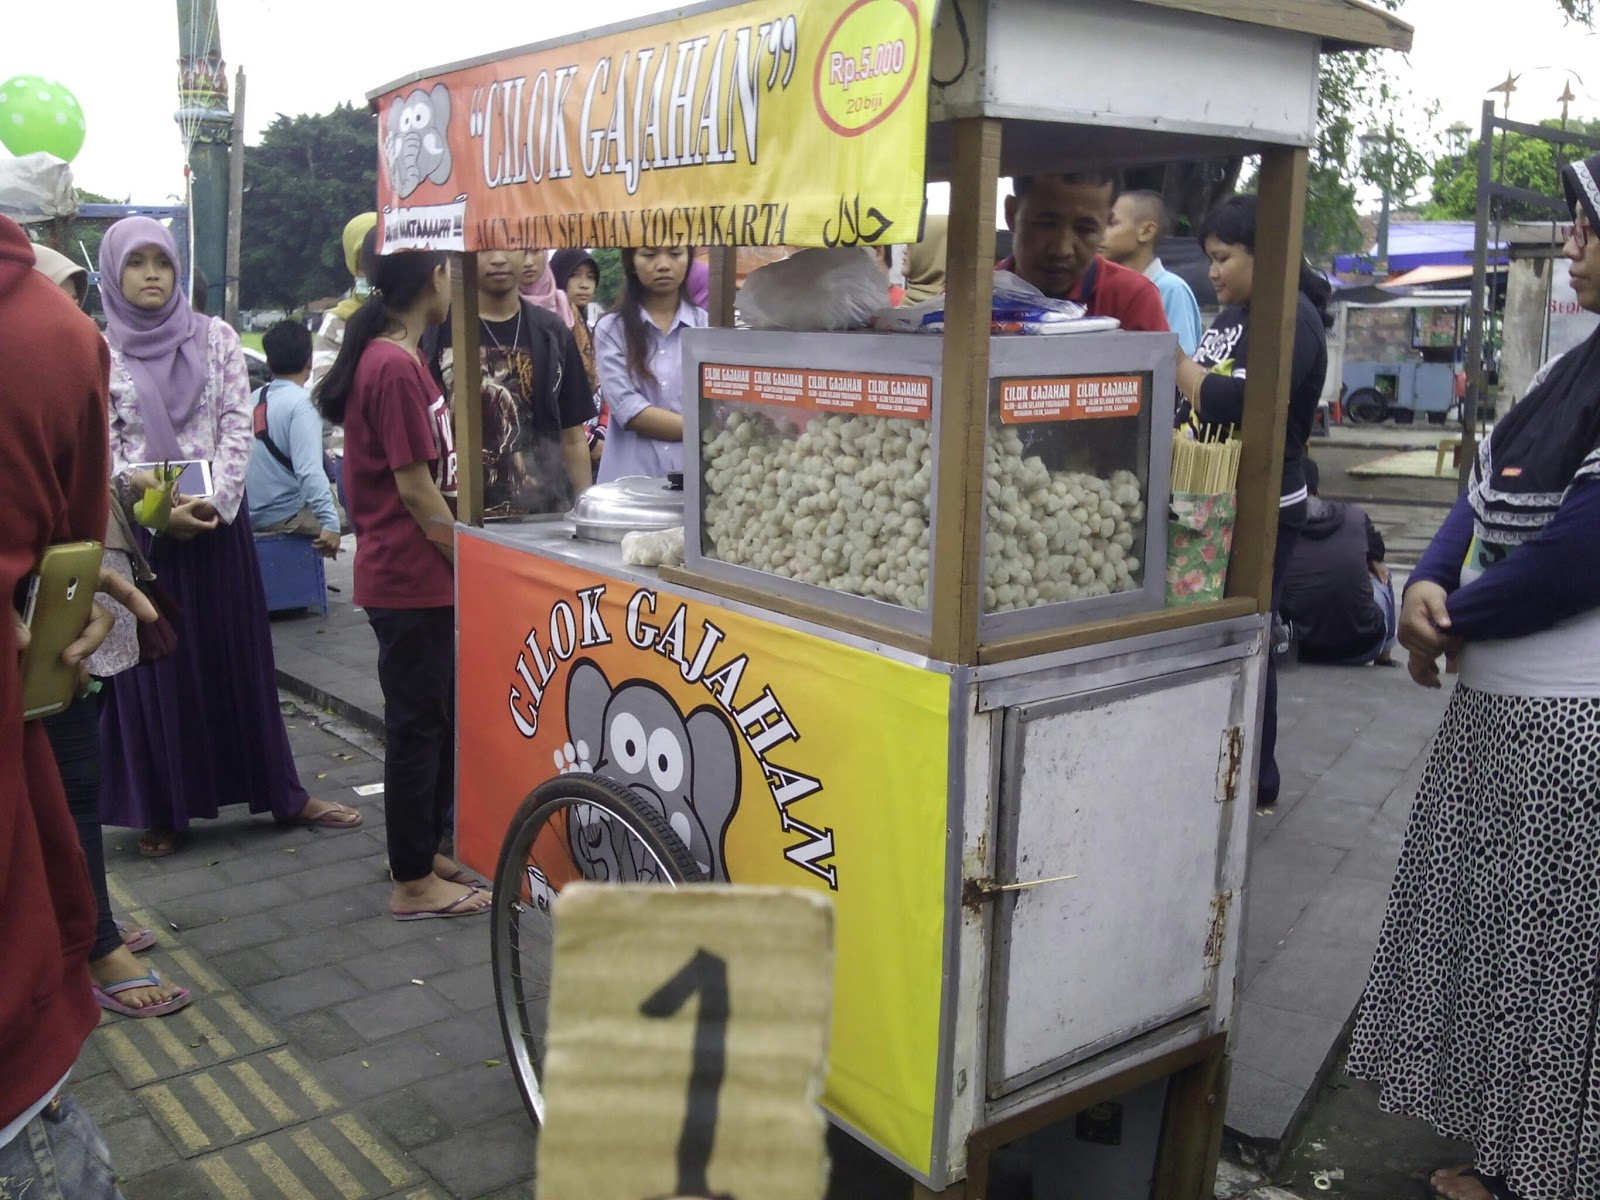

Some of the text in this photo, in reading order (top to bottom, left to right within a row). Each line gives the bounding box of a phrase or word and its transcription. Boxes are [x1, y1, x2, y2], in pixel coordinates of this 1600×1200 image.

[829, 38, 905, 92] Rp.5.000
[558, 209, 634, 250] SELATAN
[639, 202, 789, 249] YOGYAKARTA
[822, 191, 894, 249] حلال
[508, 583, 839, 891] CILOK GAJAHAN
[638, 945, 731, 1196] 1
